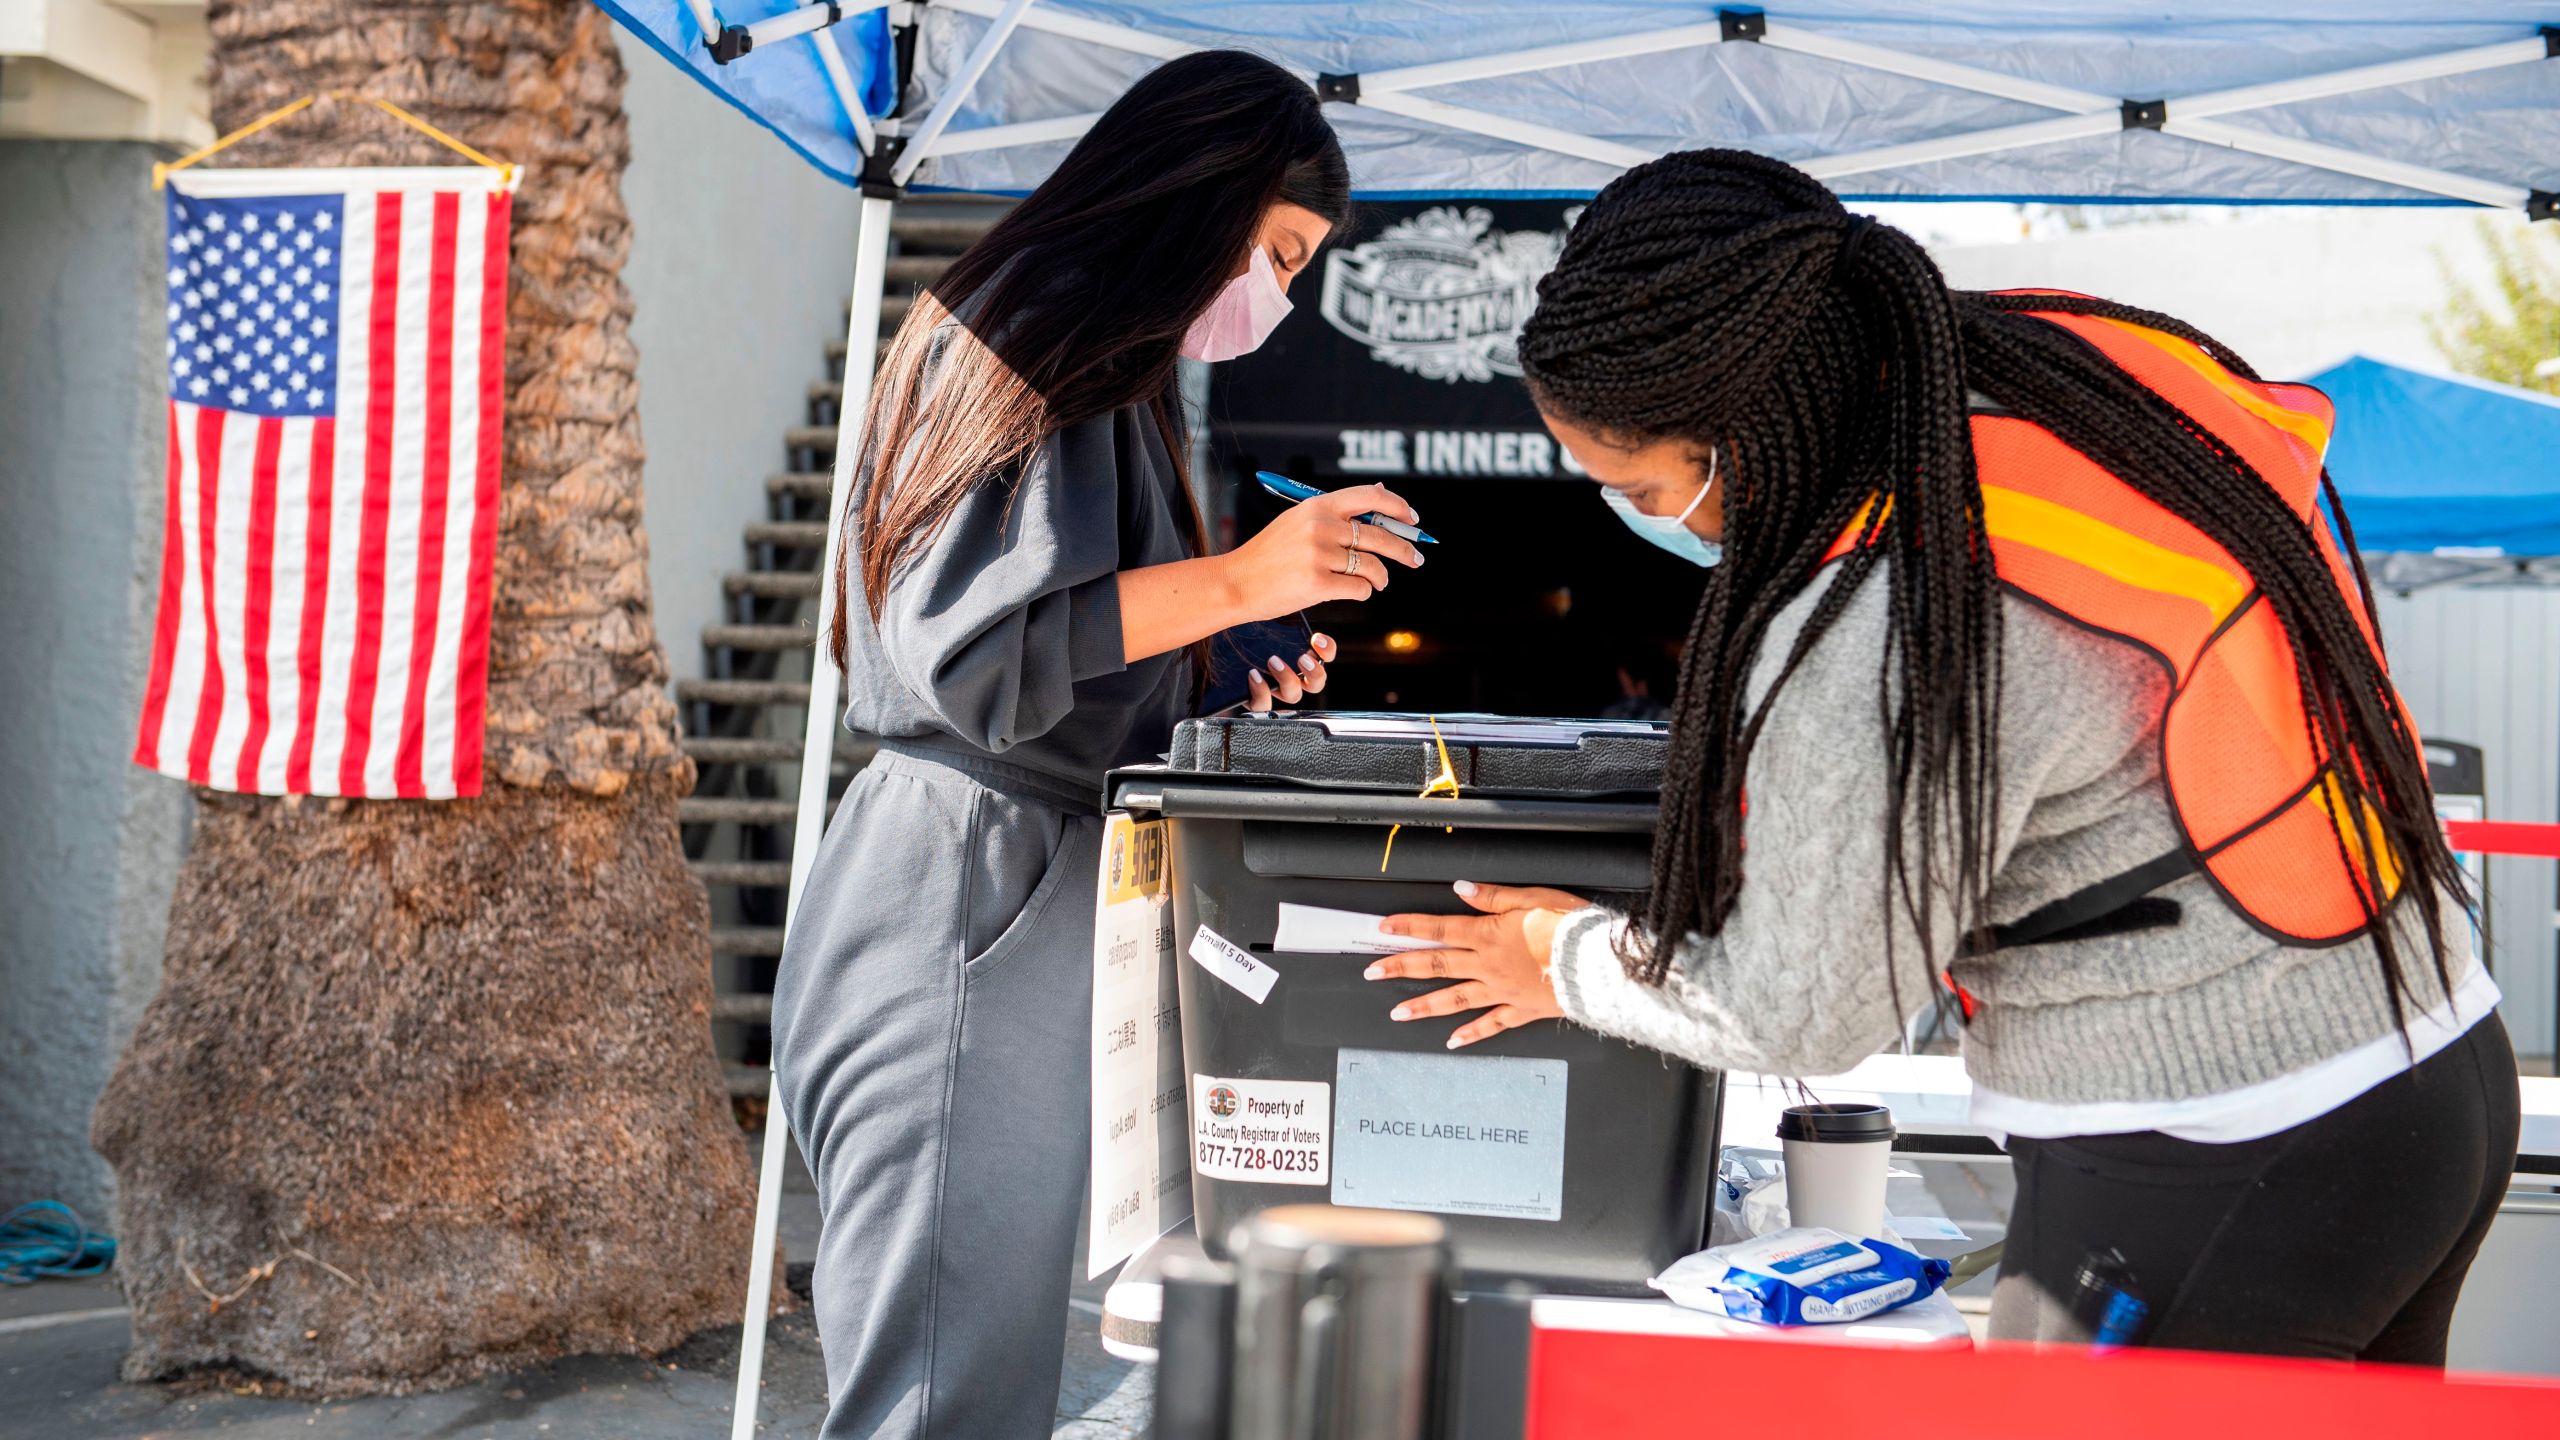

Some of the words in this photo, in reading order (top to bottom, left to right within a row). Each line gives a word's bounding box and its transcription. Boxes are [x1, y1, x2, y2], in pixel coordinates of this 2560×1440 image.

[1339, 430, 1406, 465] THE
[1414, 431, 1553, 475] INNER
[1199, 929, 1227, 953] Small
[1226, 948, 1236, 958] 5
[1235, 953, 1256, 973] Day
[1248, 1097, 1291, 1119] Property
[1294, 1099, 1304, 1115] of
[1198, 1119, 1210, 1136] L.A.
[1211, 1122, 1238, 1143] County
[1241, 1125, 1279, 1144] Registrar
[1282, 1127, 1290, 1142] of
[1293, 1128, 1320, 1143] Voters
[1359, 1119, 1416, 1137] PLACE
[1421, 1123, 1476, 1141] LABEL
[1481, 1128, 1529, 1144] HERE
[1199, 1141, 1318, 1172] 877-728-0235
